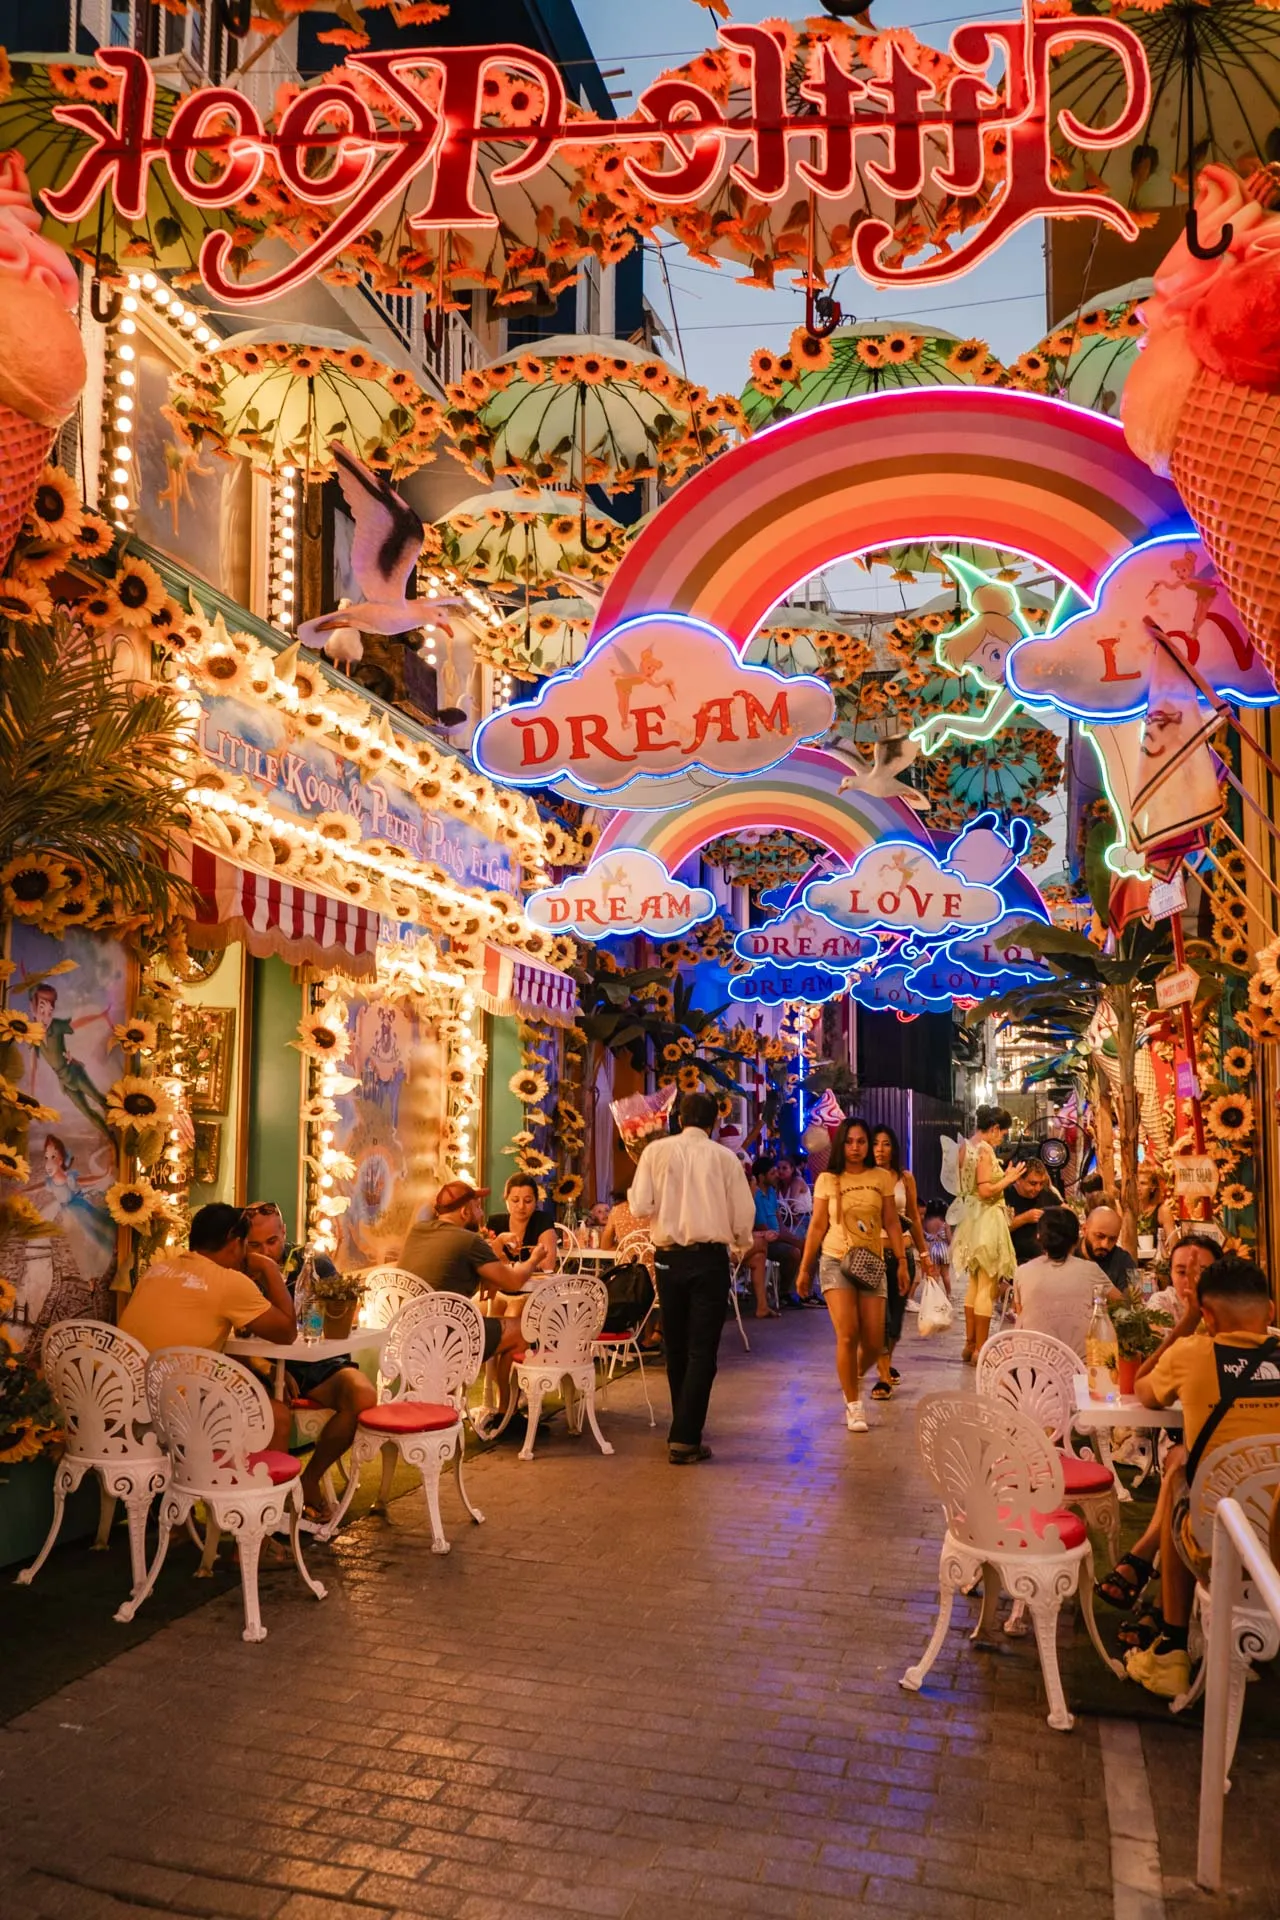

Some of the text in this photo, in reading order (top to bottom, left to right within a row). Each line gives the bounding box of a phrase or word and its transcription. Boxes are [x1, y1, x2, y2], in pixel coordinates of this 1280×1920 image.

[1097, 612, 1257, 682] LOV
[511, 690, 790, 766] DREAM
[348, 782, 364, 823] &
[546, 891, 691, 925] DREAM
[848, 884, 962, 918] LOVE
[751, 935, 861, 958] DREAM
[982, 944, 1043, 964] LOV
[744, 975, 833, 997] DREAM
[932, 973, 1000, 990] LOVE
